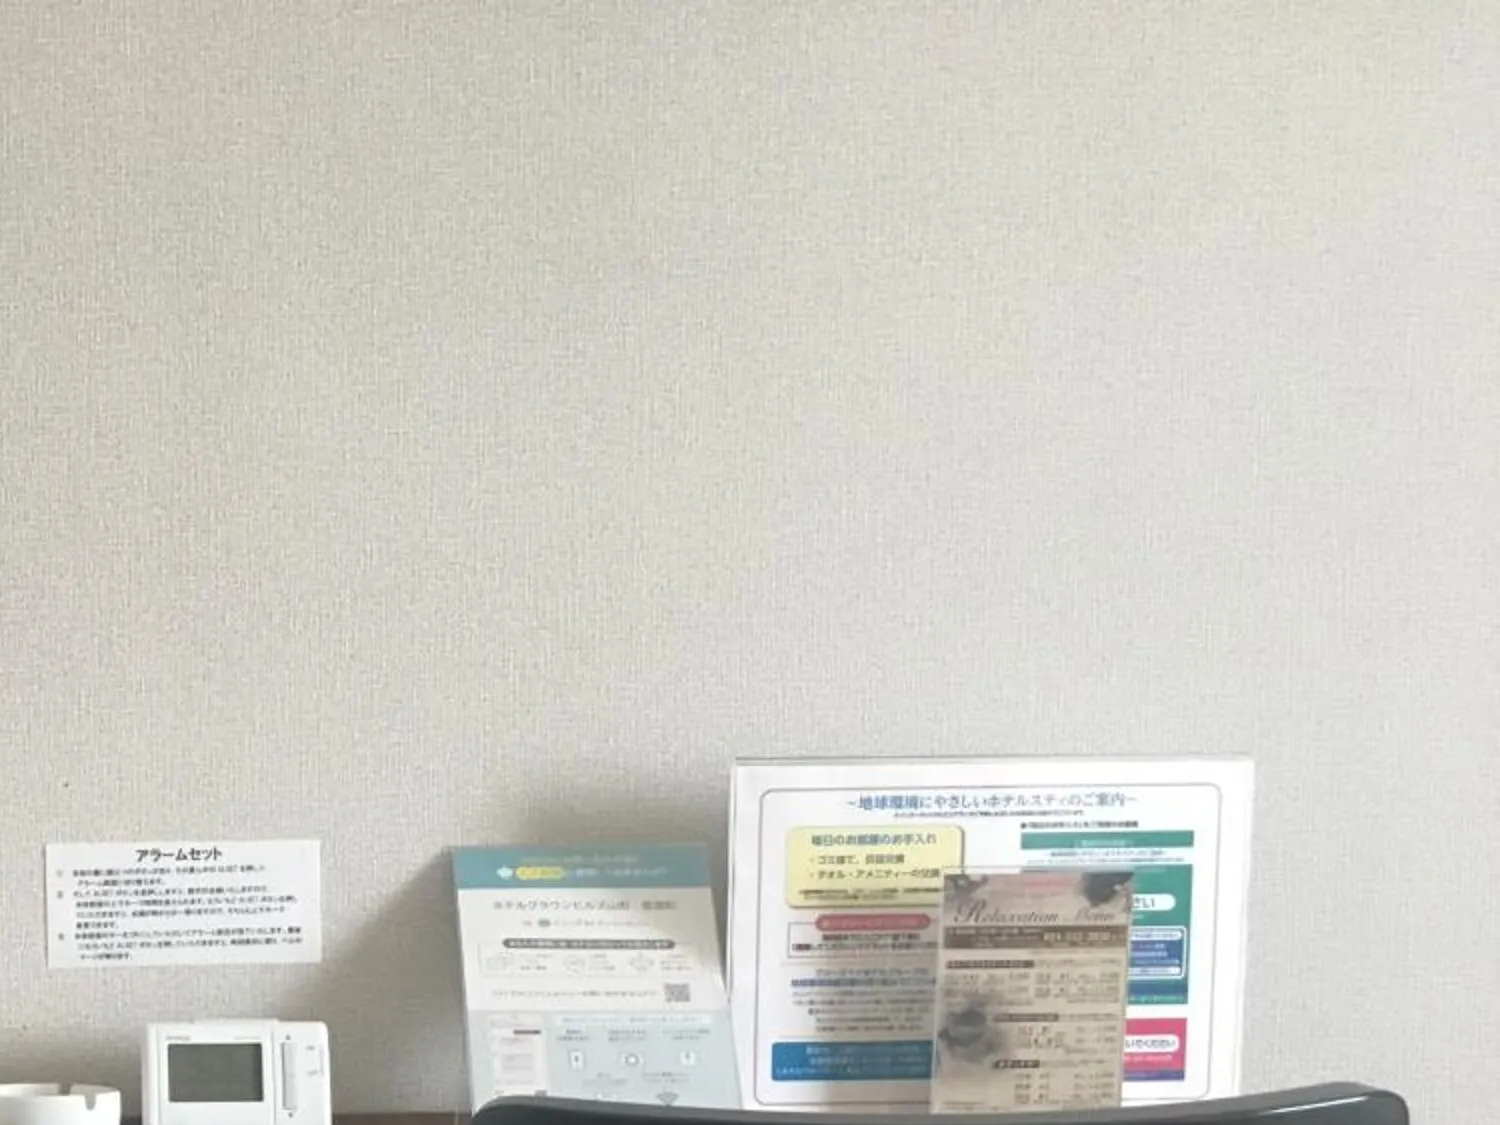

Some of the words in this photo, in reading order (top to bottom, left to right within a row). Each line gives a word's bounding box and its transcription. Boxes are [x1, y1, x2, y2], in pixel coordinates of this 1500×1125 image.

[135, 847, 223, 862] アラームセット
